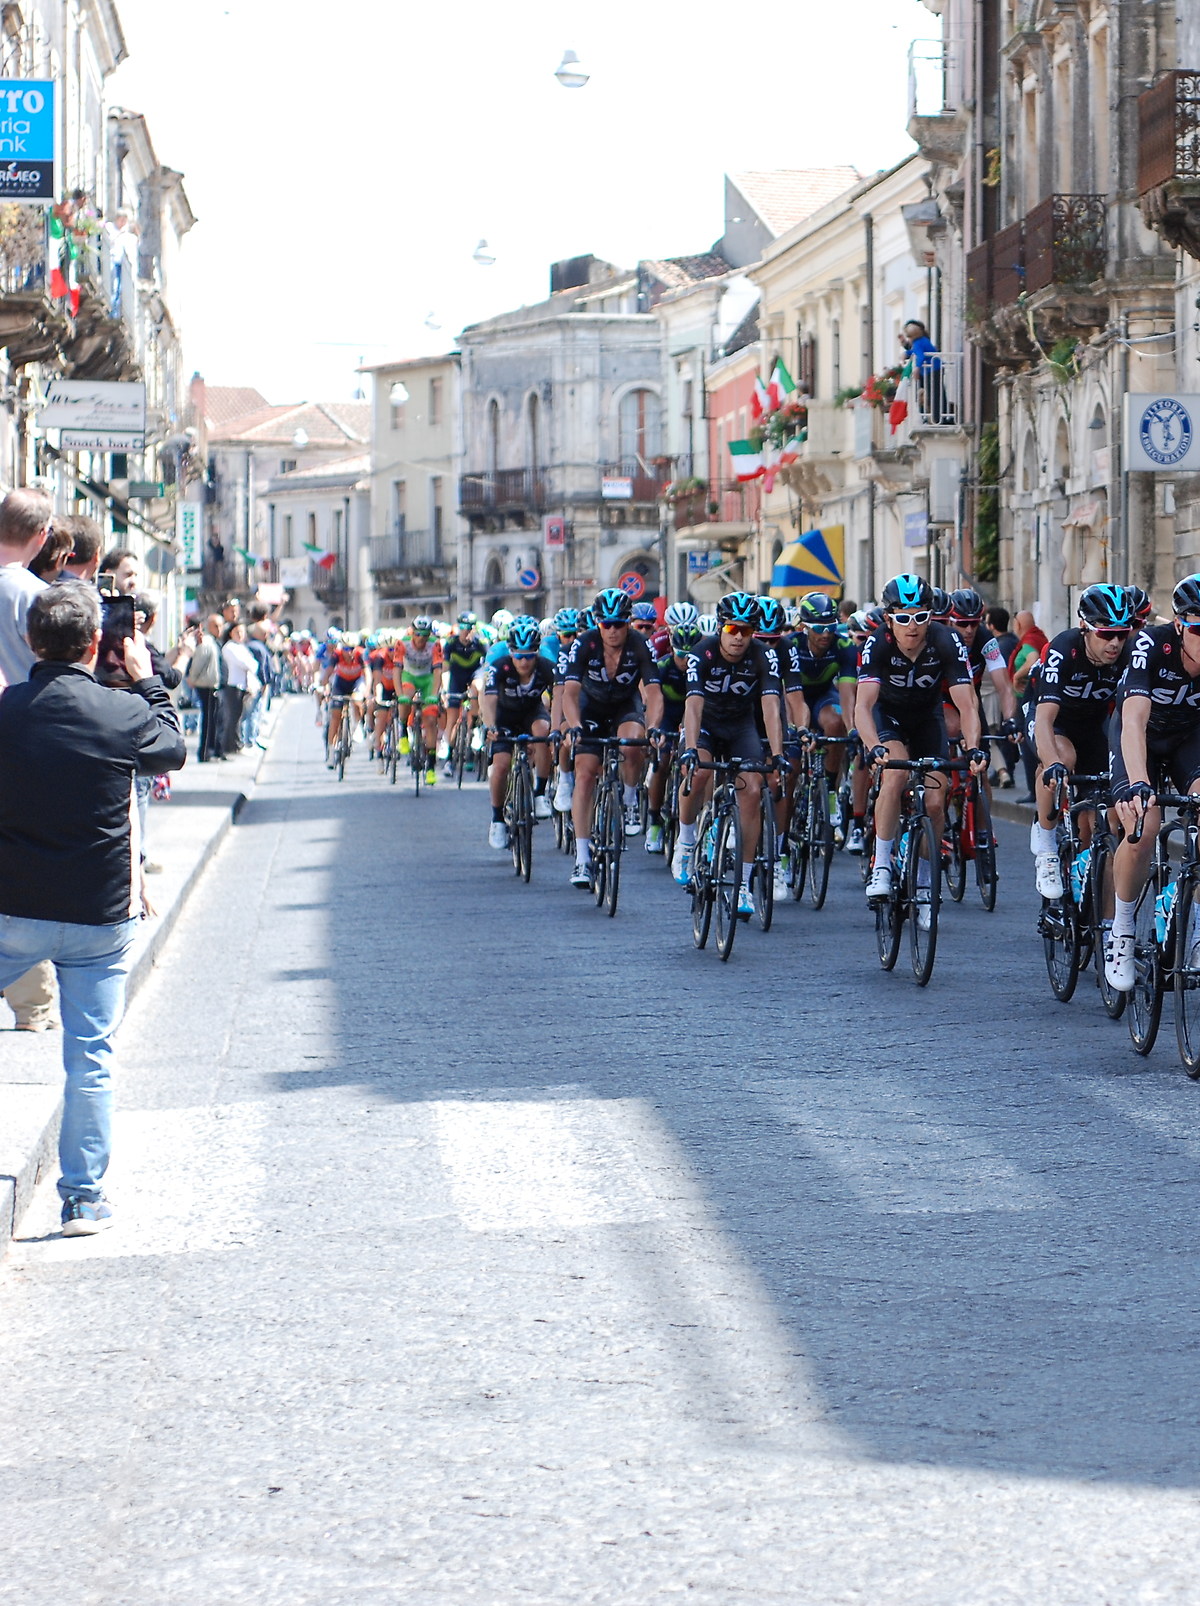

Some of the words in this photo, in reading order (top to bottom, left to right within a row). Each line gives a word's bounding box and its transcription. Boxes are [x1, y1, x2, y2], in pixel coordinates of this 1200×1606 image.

[1145, 401, 1187, 420] VITTORIA
[64, 435, 103, 448] Snack
[108, 437, 130, 449] bar
[1142, 432, 1190, 462] ASSICURAZIONI
[765, 648, 780, 678] sky
[861, 635, 877, 665] sky
[1132, 631, 1155, 669] sky
[686, 653, 700, 683] sky
[1045, 649, 1064, 684] sky
[705, 675, 759, 696] sky
